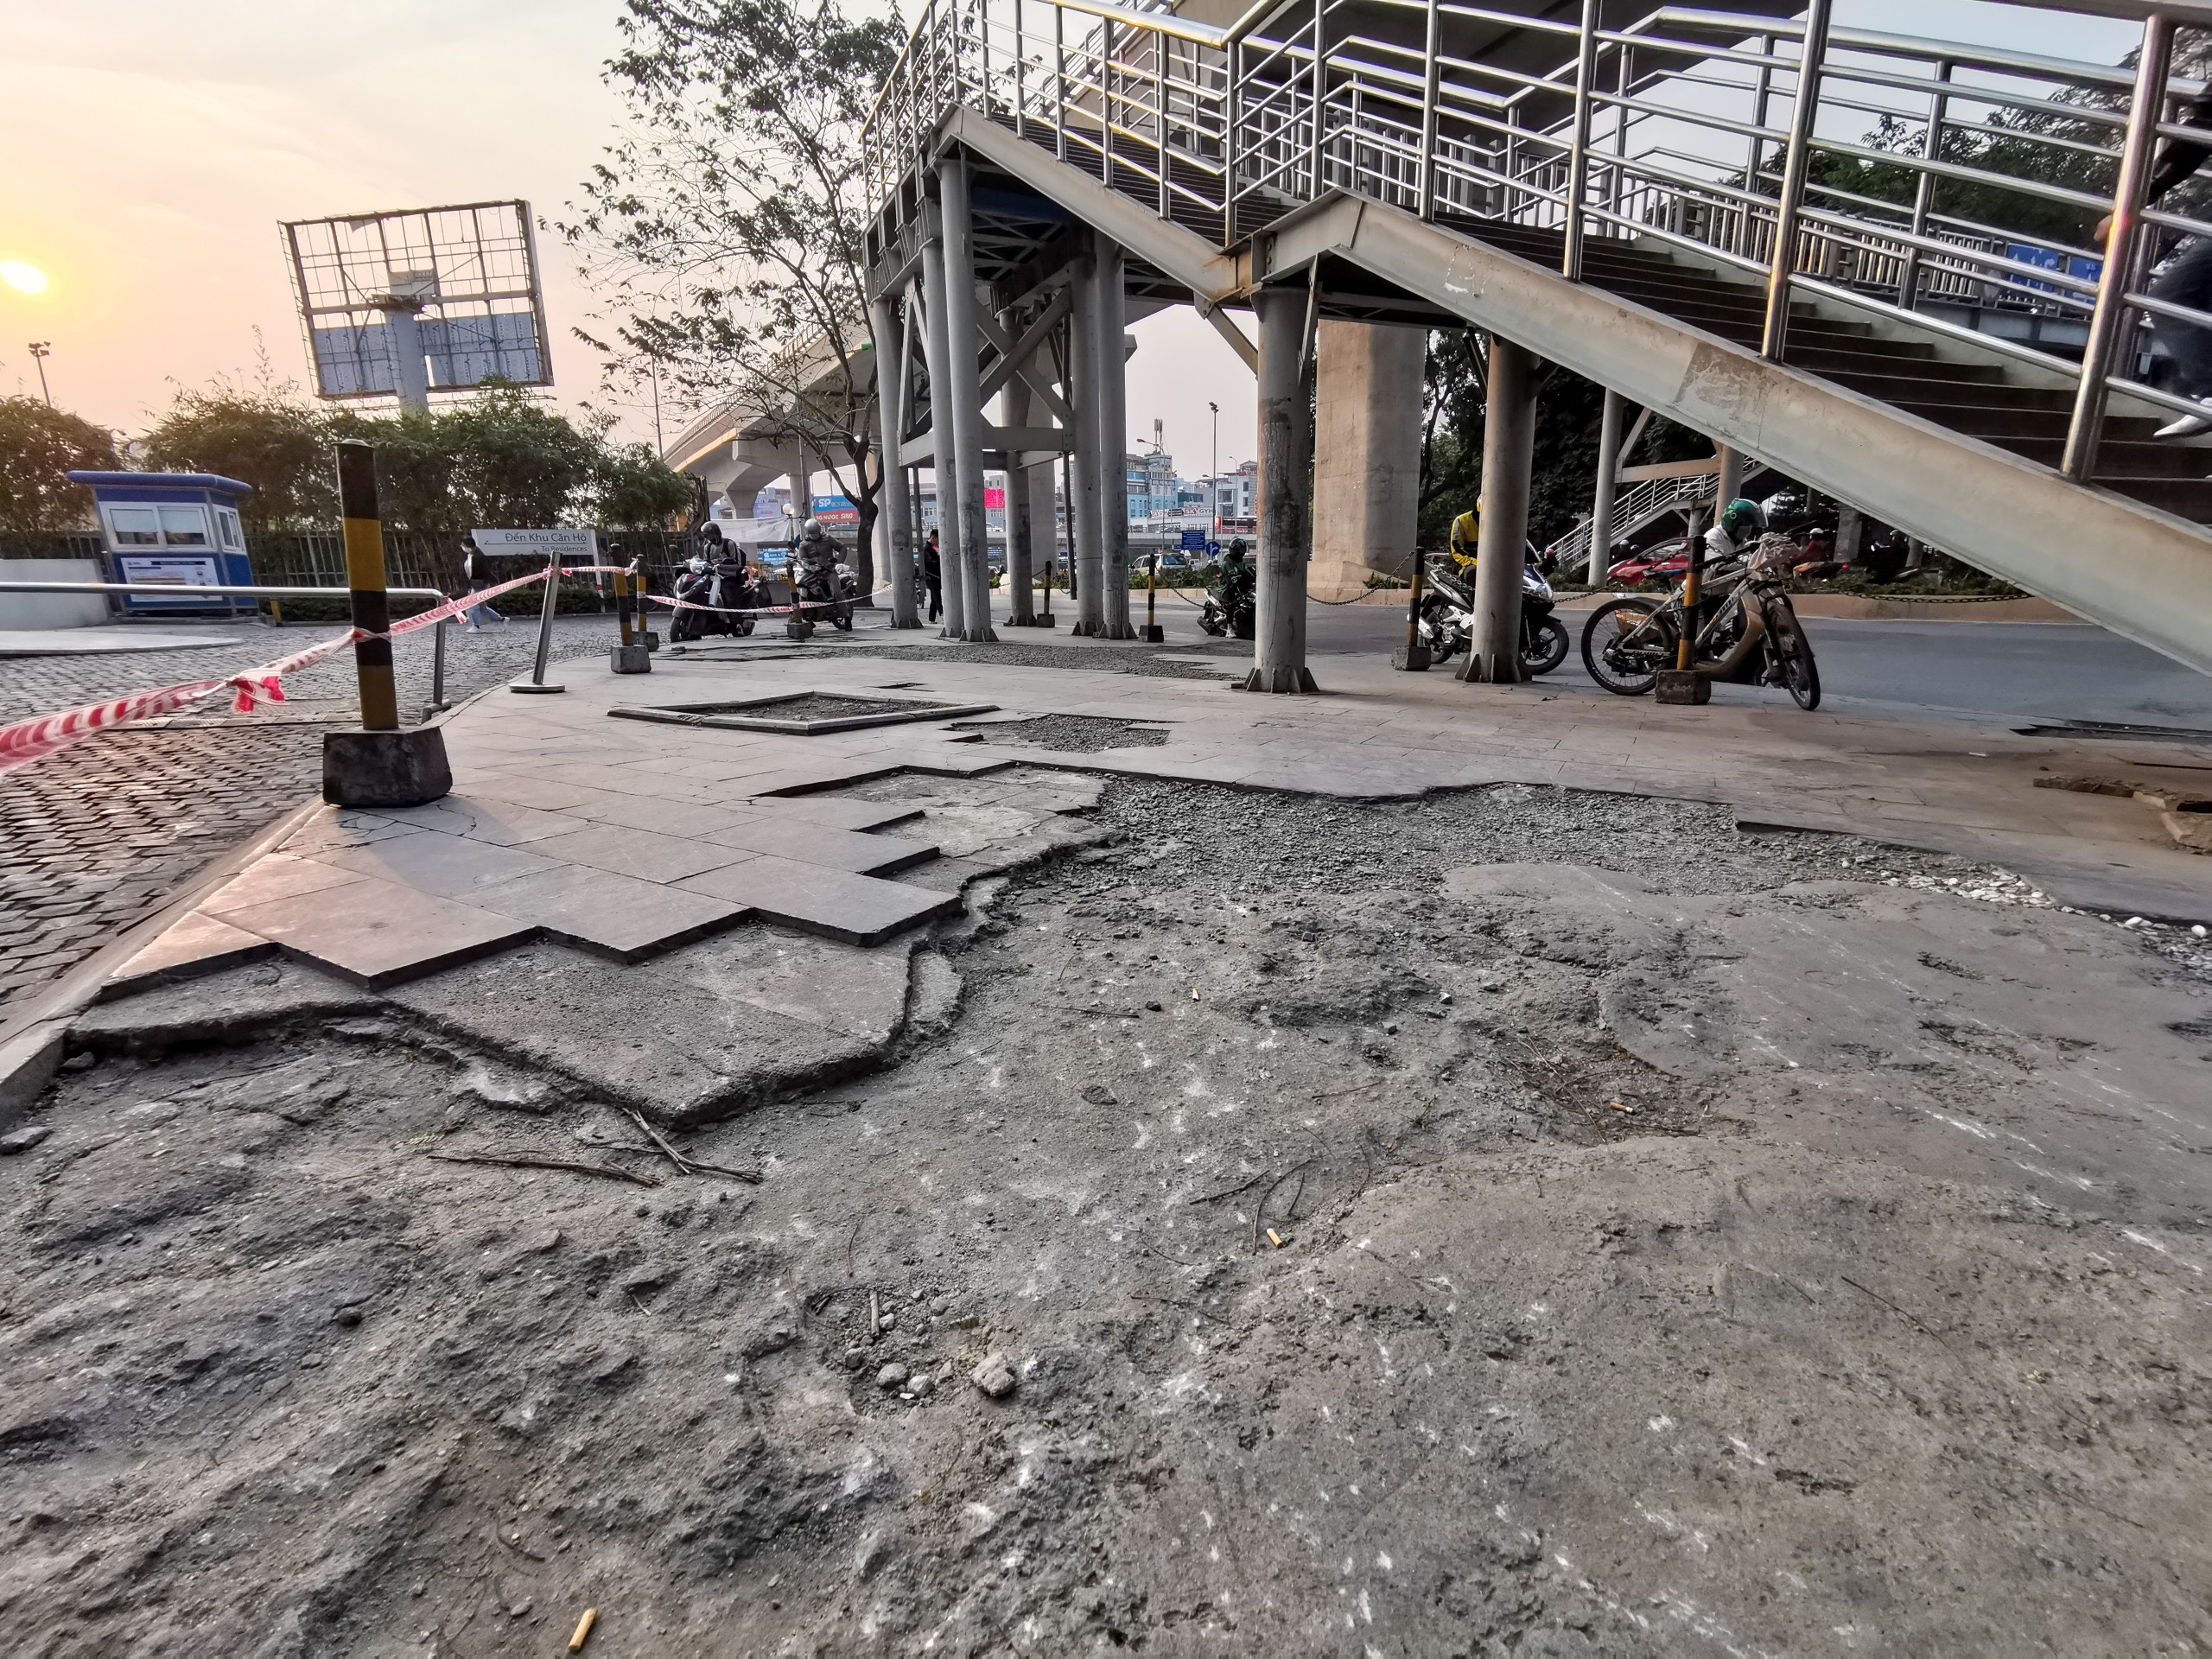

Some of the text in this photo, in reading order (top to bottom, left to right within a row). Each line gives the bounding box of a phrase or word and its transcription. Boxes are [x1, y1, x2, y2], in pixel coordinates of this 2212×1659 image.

[818, 499, 830, 507] SP
[505, 532, 525, 542] Đến
[529, 533, 549, 542] Khu
[551, 533, 570, 542] Căn
